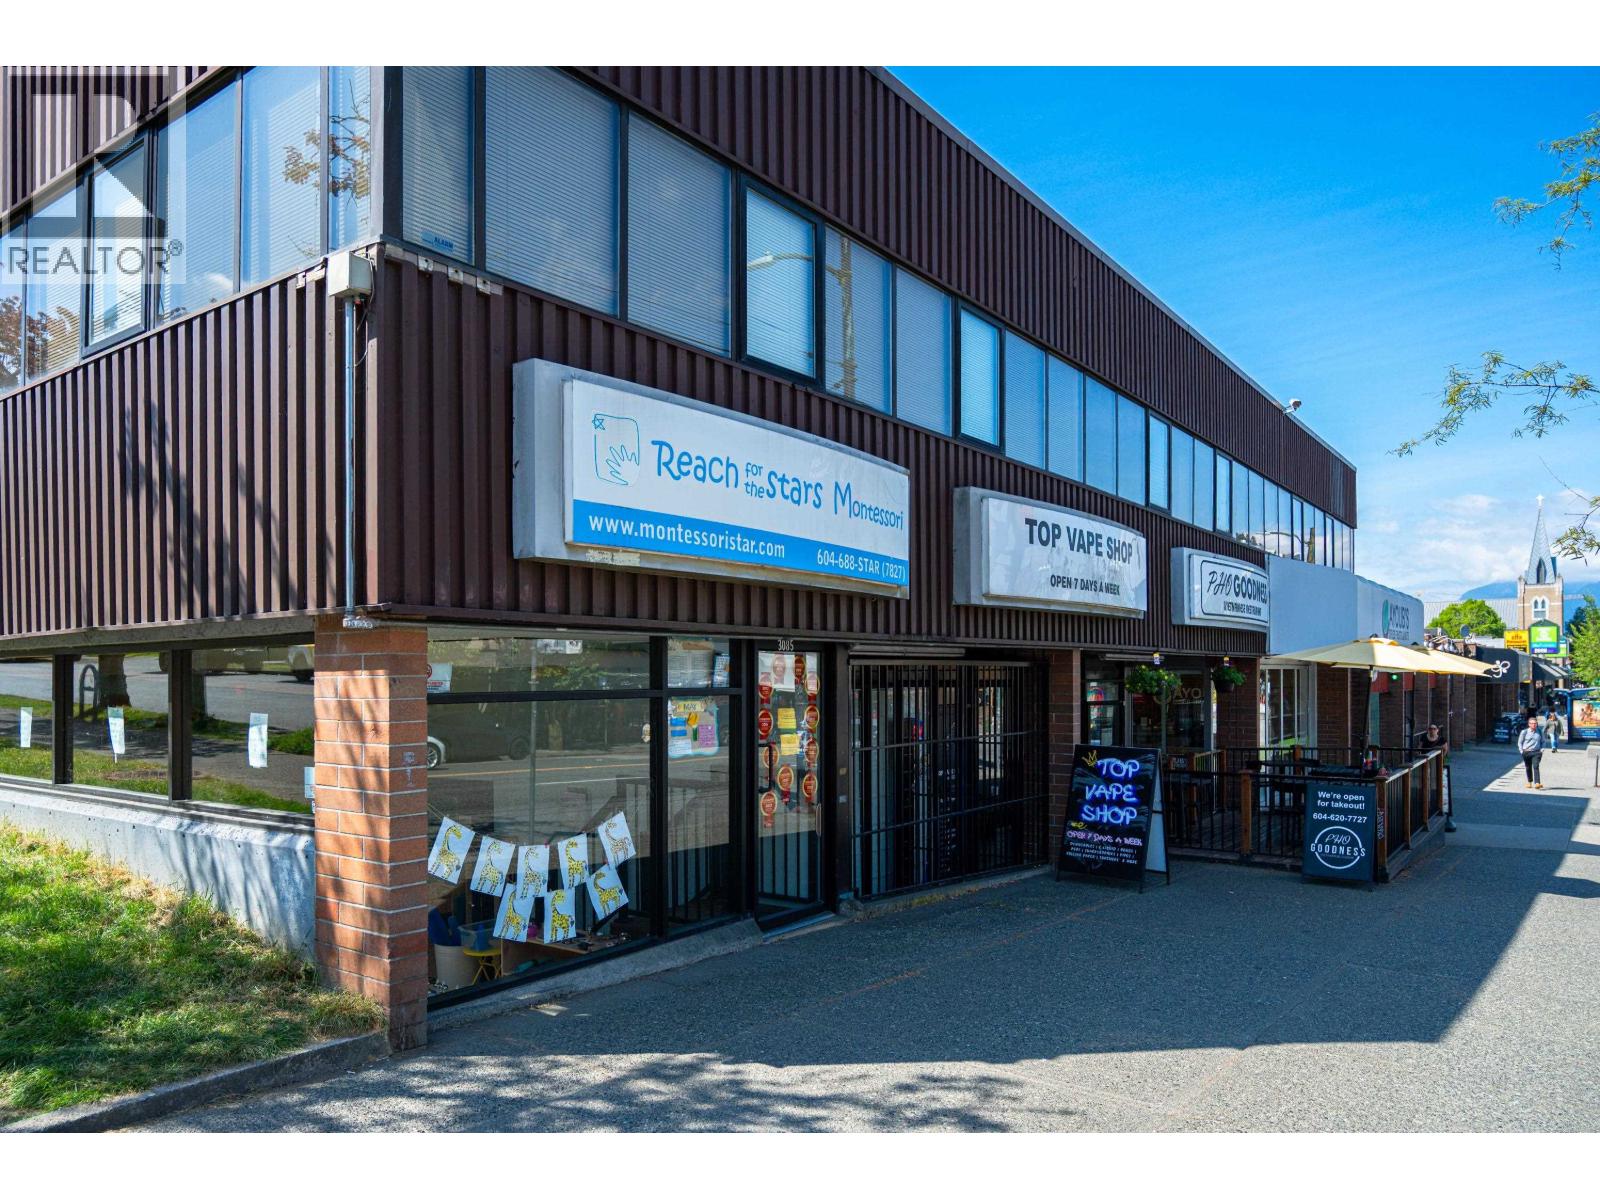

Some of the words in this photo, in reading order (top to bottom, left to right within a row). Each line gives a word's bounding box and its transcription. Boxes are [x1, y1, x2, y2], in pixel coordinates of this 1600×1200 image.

[651, 440, 739, 489] Reach
[745, 462, 764, 478] for
[743, 481, 765, 499] the
[833, 481, 904, 531] Montessori
[588, 515, 785, 559] www.montessoristar.com
[1024, 517, 1062, 548] TOP
[1066, 526, 1103, 557] VAPE
[1106, 536, 1133, 564] SHOP
[817, 549, 880, 576] 604-688-STAR
[881, 561, 906, 582] (7827)
[1050, 574, 1072, 589] OPEN
[1074, 578, 1079, 590] 7
[1080, 579, 1098, 593] DAYS
[1099, 583, 1104, 593] A
[1104, 583, 1120, 596] WEEK
[1207, 570, 1232, 596] PHO
[1097, 758, 1139, 777] TOP
[1085, 783, 1137, 803] VAPE
[1317, 791, 1341, 800] We're
[1344, 792, 1365, 801] open
[1082, 804, 1137, 824] SHOP
[1331, 801, 1365, 810] takeout!
[1312, 813, 1367, 823] 604-620-7727
[1066, 830, 1086, 840] OPEN
[1093, 833, 1114, 843] DAYS
[1325, 833, 1351, 845] PHO
[1310, 843, 1366, 857] GOODNESS
